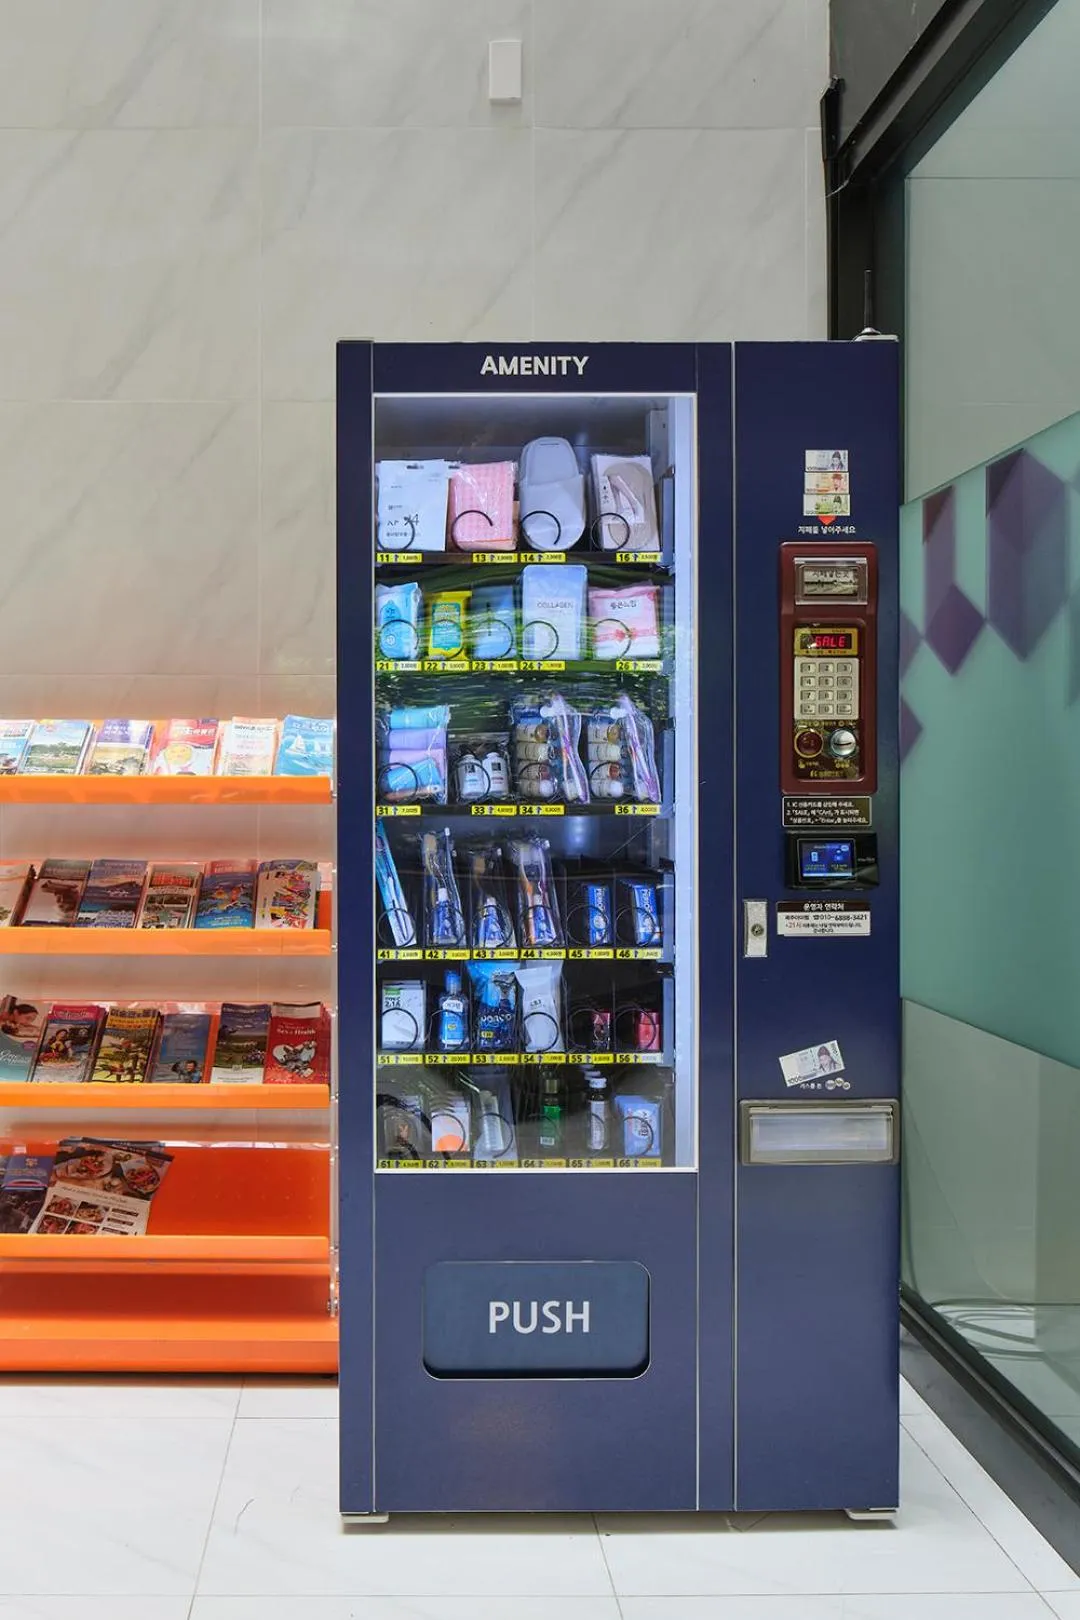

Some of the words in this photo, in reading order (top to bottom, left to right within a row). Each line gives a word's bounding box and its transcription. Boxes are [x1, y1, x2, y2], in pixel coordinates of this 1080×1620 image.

[480, 355, 590, 376] AMENITY
[798, 526, 819, 534] 지폐를
[821, 526, 856, 534] 넣어주세요
[536, 601, 573, 609] COLLAGEN
[803, 903, 823, 911] 운영자
[824, 903, 844, 911] 연락처
[489, 1301, 590, 1334] PUSH
